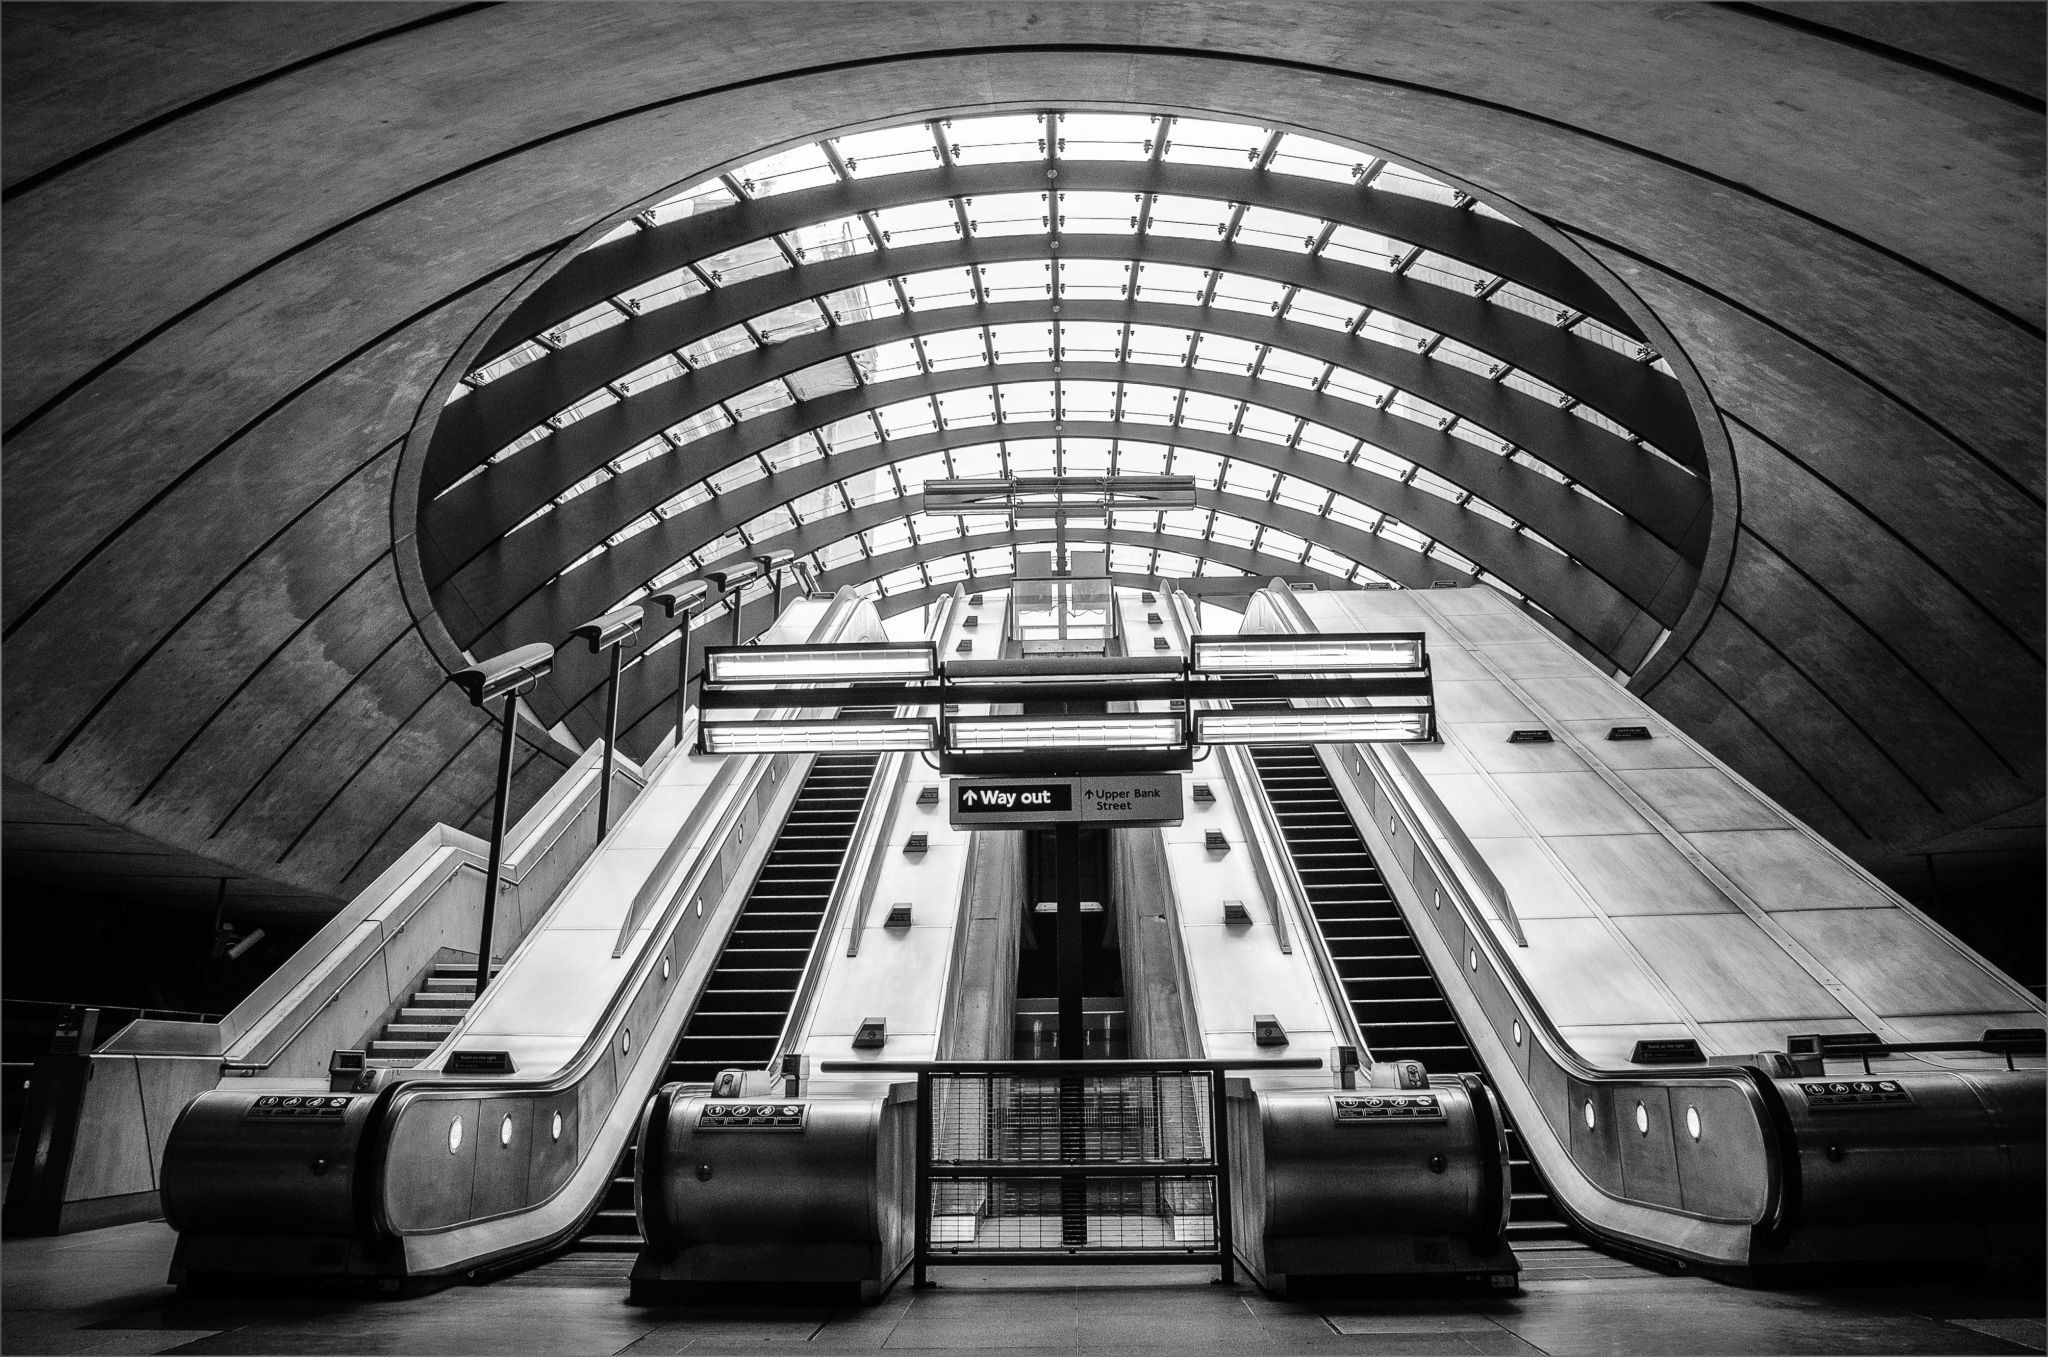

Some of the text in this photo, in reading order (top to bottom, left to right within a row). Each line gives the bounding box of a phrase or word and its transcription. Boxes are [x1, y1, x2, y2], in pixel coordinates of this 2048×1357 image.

[980, 790, 1051, 807] Way out
[1095, 788, 1161, 801] Upper Bank
[1096, 801, 1132, 811] Street
